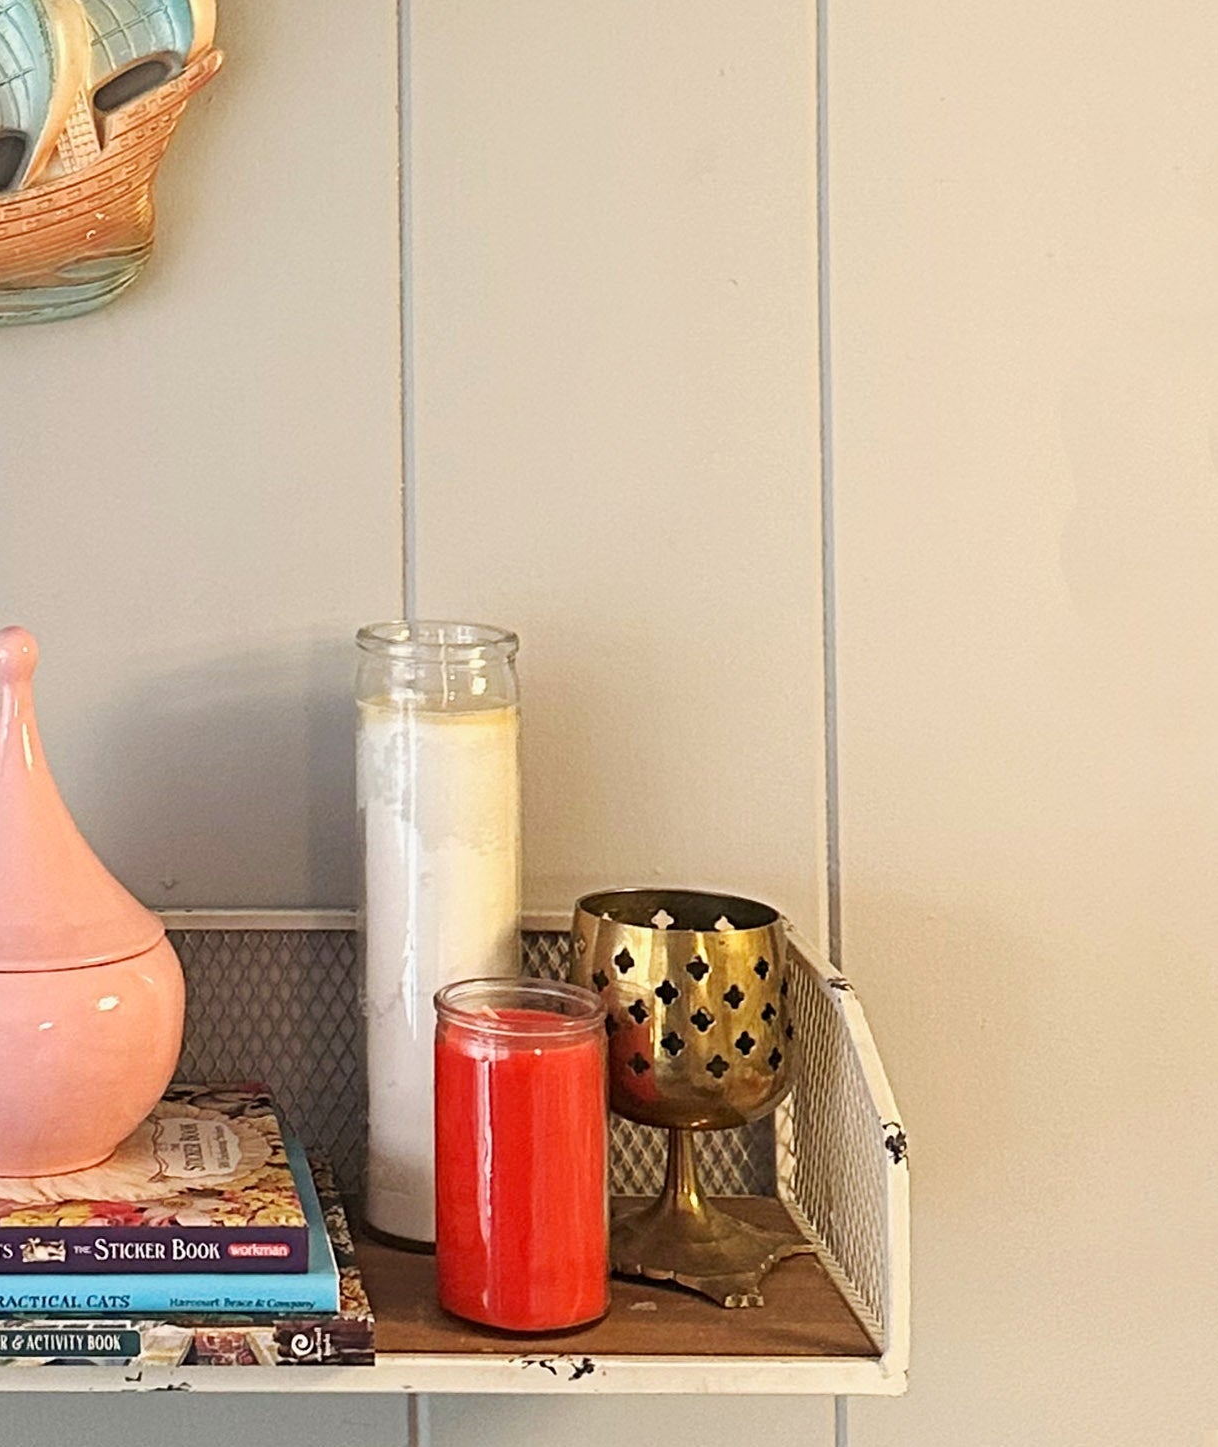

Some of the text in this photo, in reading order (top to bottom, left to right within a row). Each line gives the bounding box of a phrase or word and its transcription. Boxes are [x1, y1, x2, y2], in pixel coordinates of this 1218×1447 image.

[93, 1238, 166, 1261] STICKER
[171, 1238, 221, 1261] BOOK
[230, 1243, 289, 1258] workman
[86, 1295, 130, 1309] CATS
[11, 1334, 24, 1351] &
[27, 1334, 83, 1351] ACTIVITY
[87, 1334, 121, 1351] BOOK
